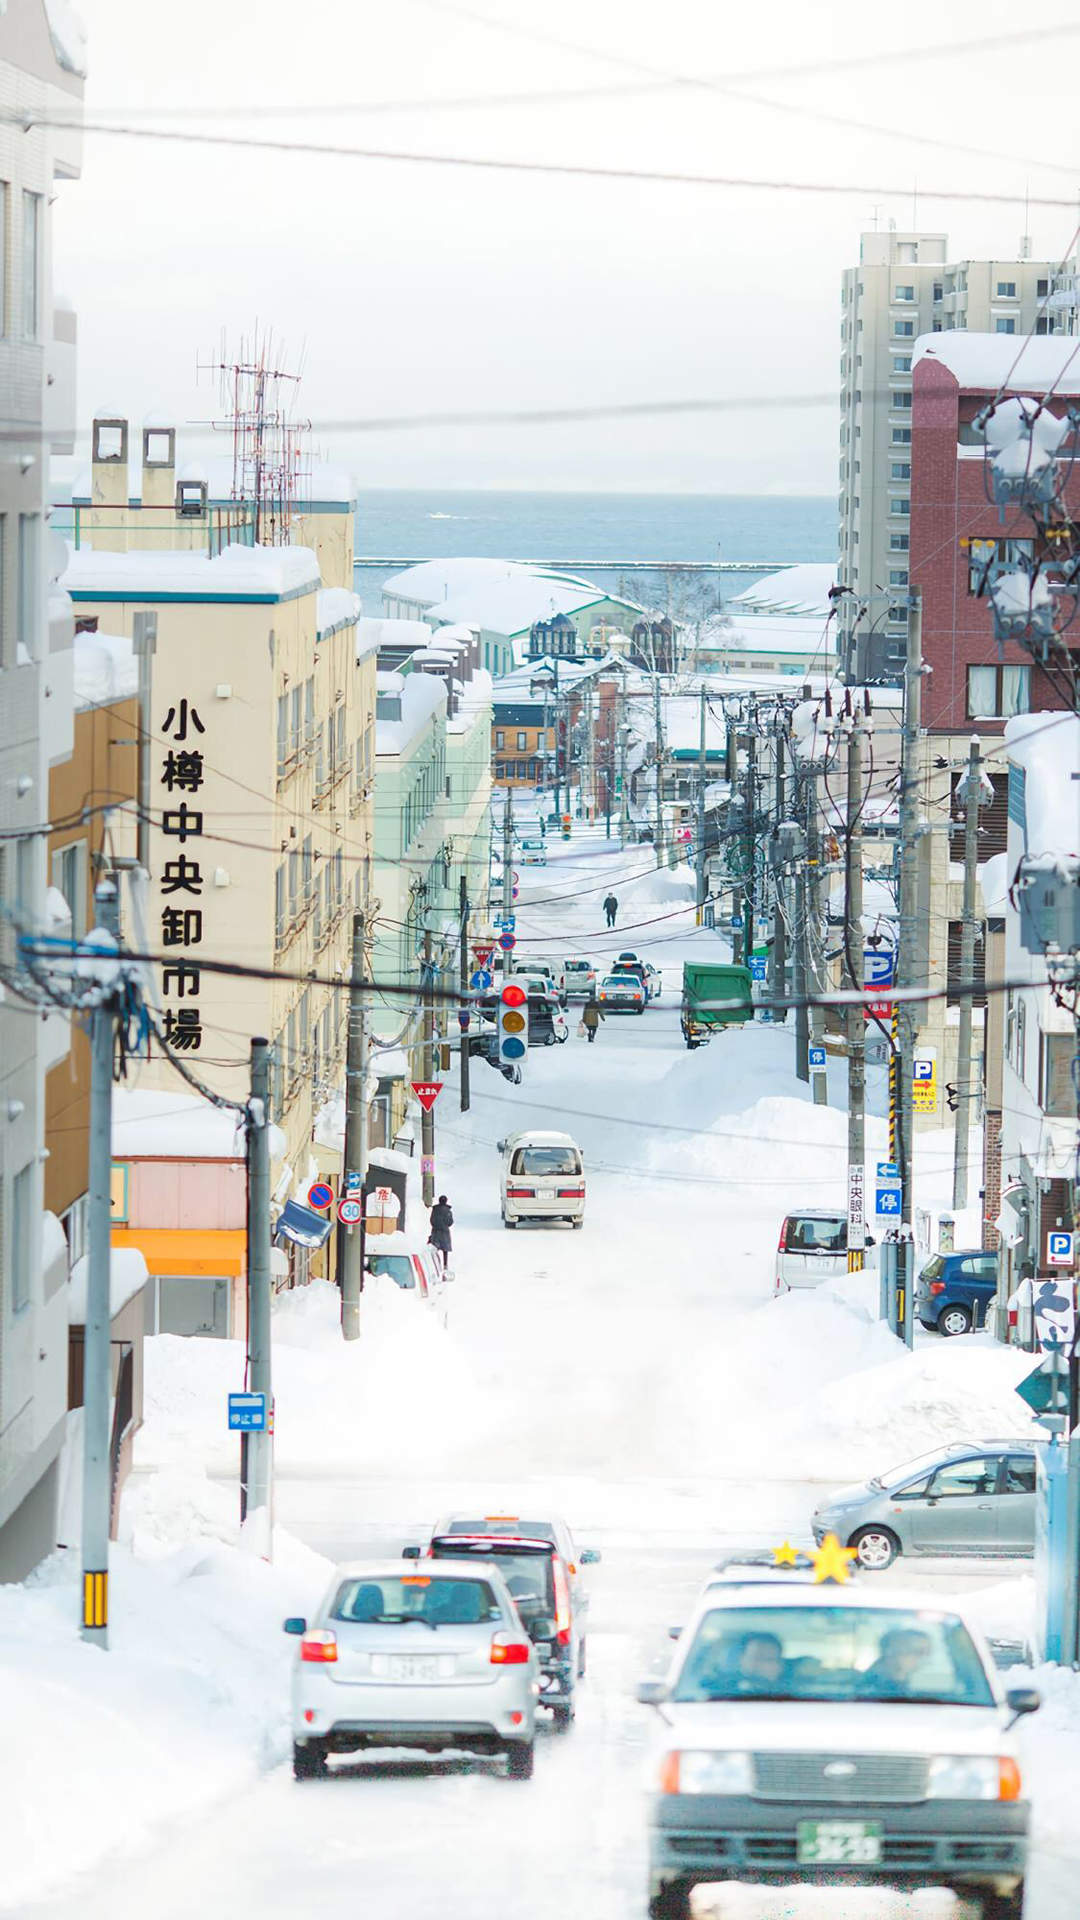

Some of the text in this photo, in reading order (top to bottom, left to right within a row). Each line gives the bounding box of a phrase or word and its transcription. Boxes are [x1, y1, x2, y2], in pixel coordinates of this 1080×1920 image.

[160, 698, 206, 1051] 小樽中央卸市場
[864, 956, 890, 982] P
[915, 1061, 931, 1079] P
[850, 1174, 863, 1225] 中央眼科
[879, 1193, 898, 1211] 停
[343, 1204, 359, 1218] 30
[1053, 1236, 1069, 1253] P
